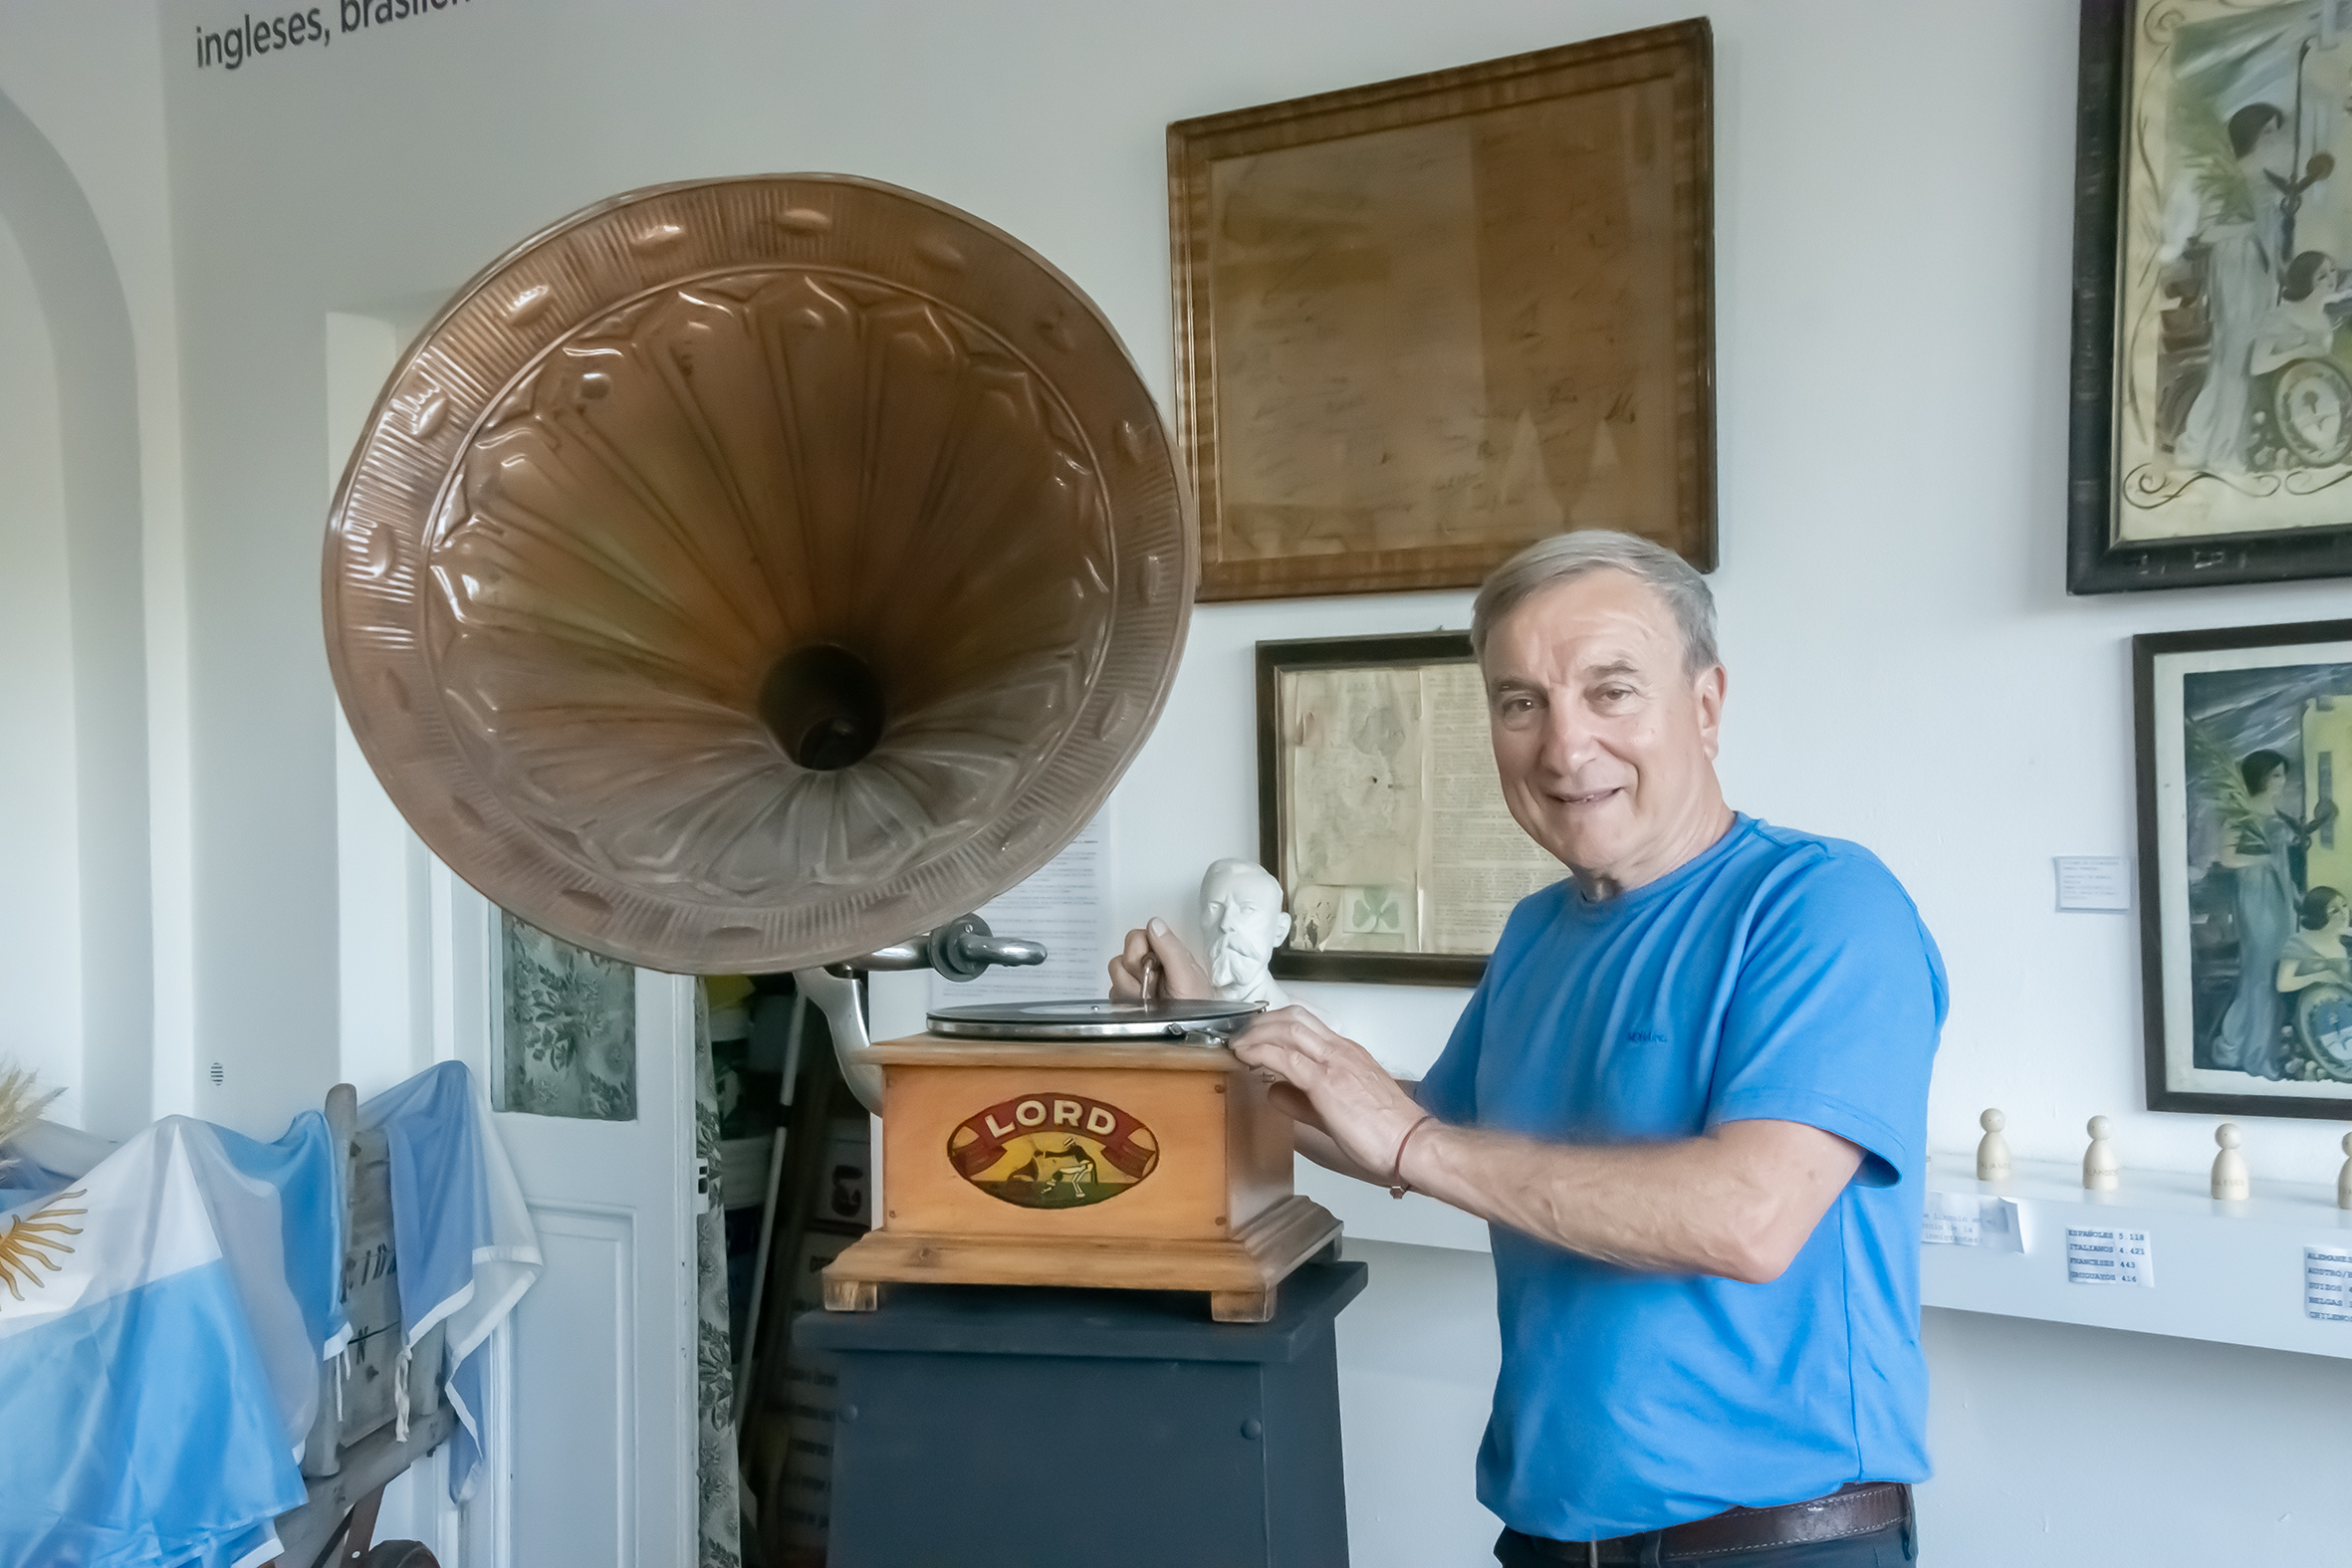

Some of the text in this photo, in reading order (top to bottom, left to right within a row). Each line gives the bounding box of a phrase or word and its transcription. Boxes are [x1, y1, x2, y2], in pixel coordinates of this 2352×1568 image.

[195, 7, 331, 70] ingleses,
[984, 1099, 1116, 1138] LORD
[2069, 1243, 2114, 1253] ITALIANOS
